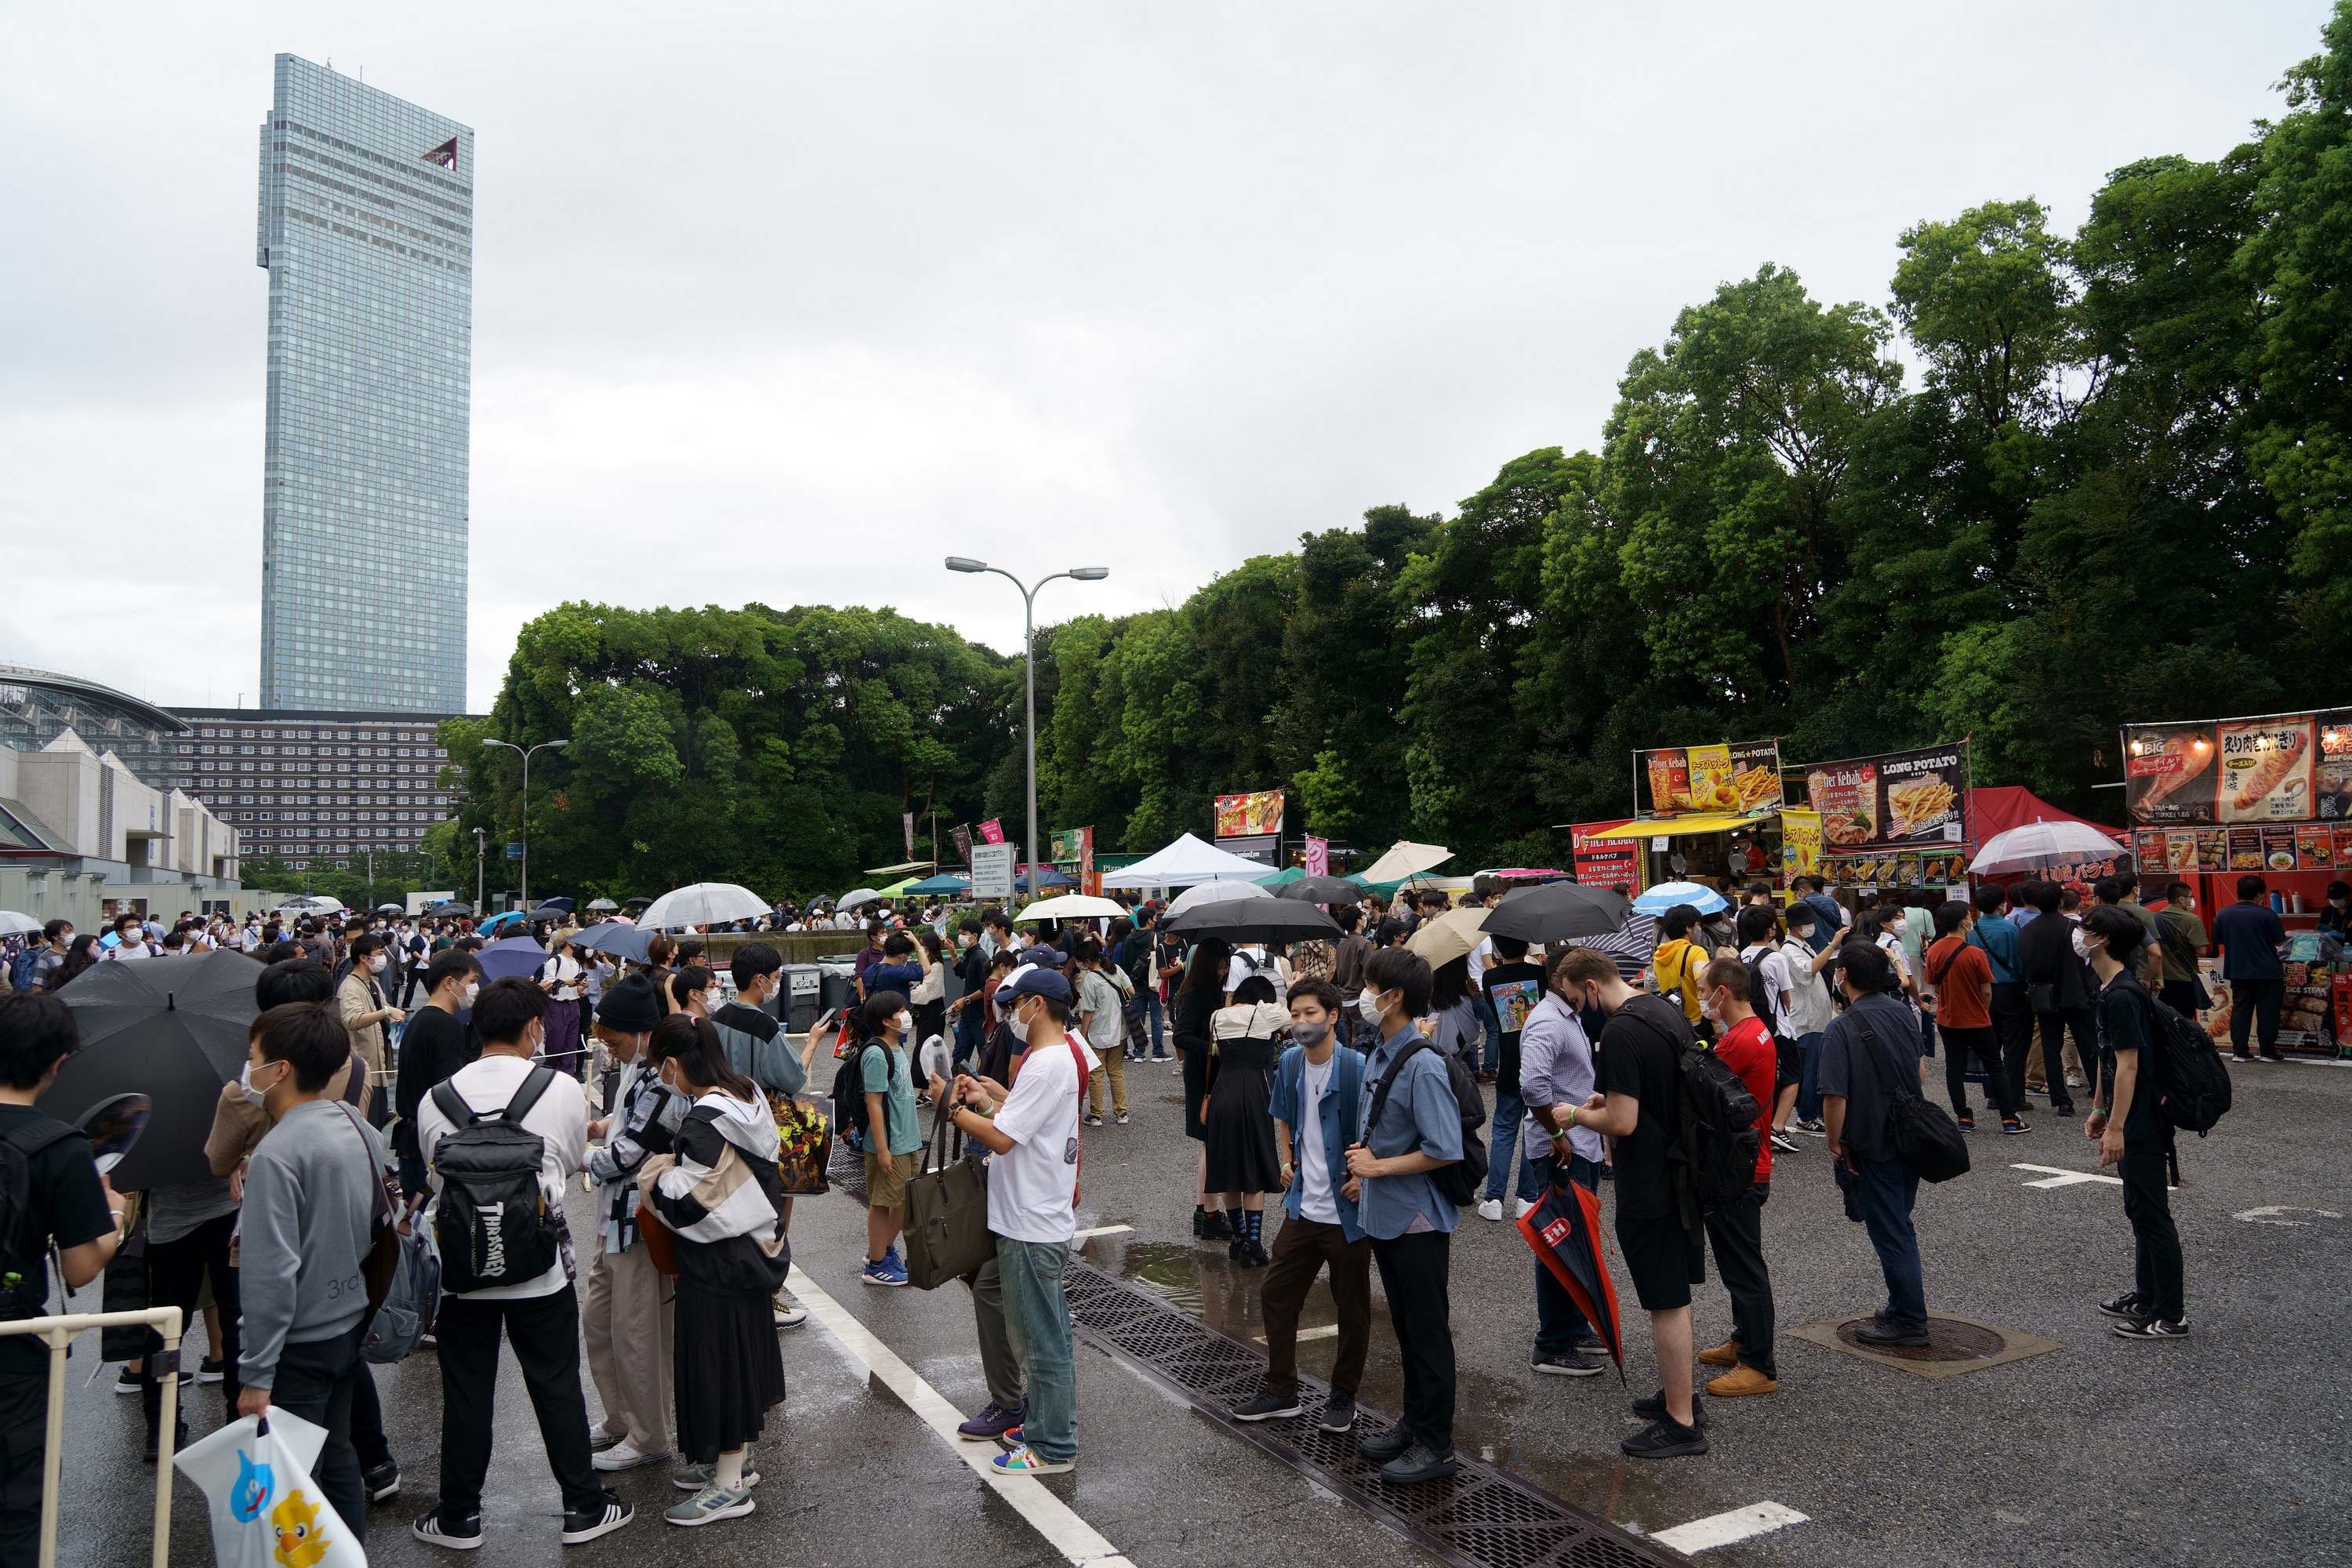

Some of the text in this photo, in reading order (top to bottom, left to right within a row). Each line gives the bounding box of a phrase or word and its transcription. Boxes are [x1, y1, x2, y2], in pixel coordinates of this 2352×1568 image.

[1751, 748, 1775, 757] POTATO
[1668, 757, 1686, 768] Kebab
[1692, 759, 1730, 770] チーズハットグ
[1882, 755, 1957, 775] LONG POTATO
[1837, 770, 1860, 786] Kebab
[1058, 864, 1071, 873] Pizza
[476, 1201, 506, 1277] THRASHER
